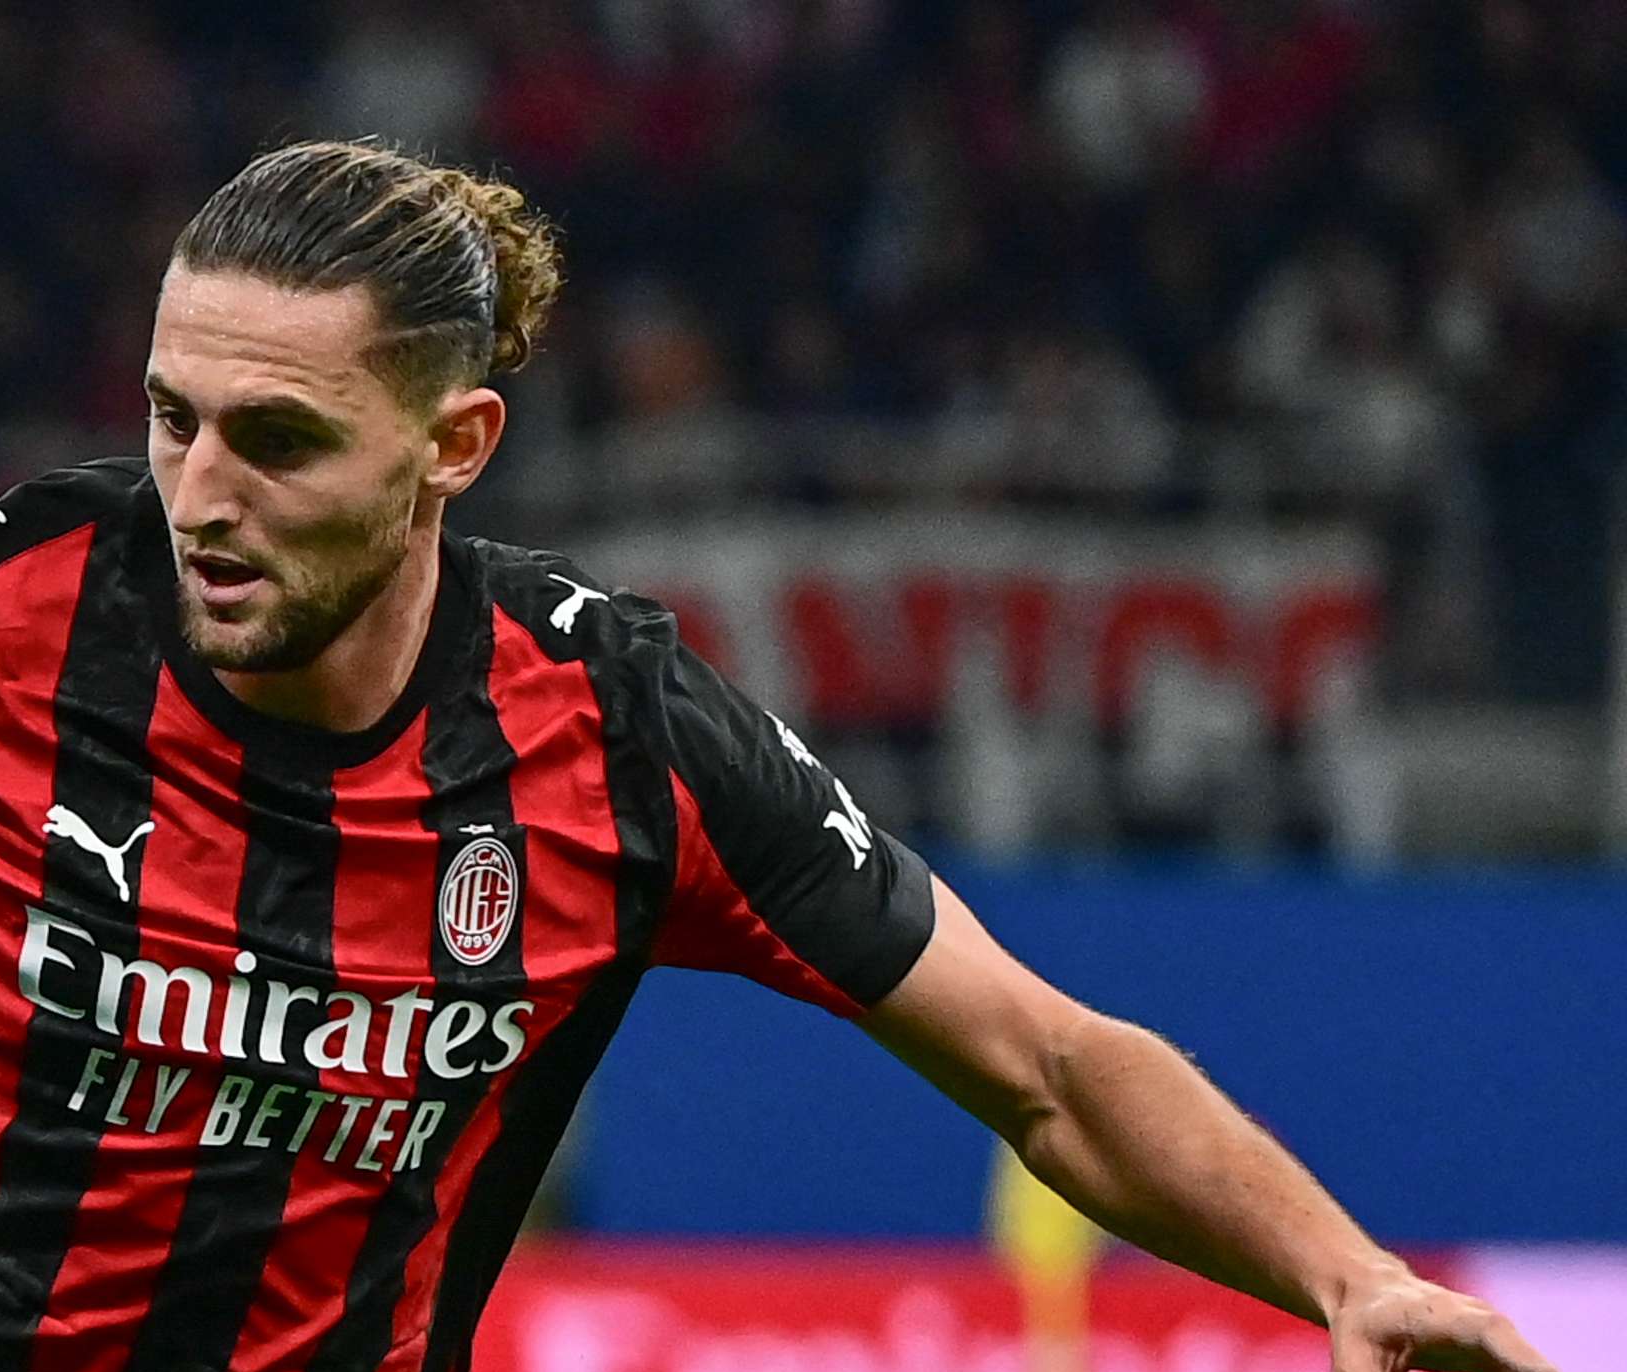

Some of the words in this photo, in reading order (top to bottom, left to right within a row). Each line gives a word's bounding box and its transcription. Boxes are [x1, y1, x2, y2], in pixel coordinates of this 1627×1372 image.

[462, 848, 503, 870] ACM
[456, 933, 493, 949] 1899
[18, 904, 535, 1079] Emirates
[67, 1047, 191, 1134] FLY
[199, 1074, 446, 1174] BETTER
